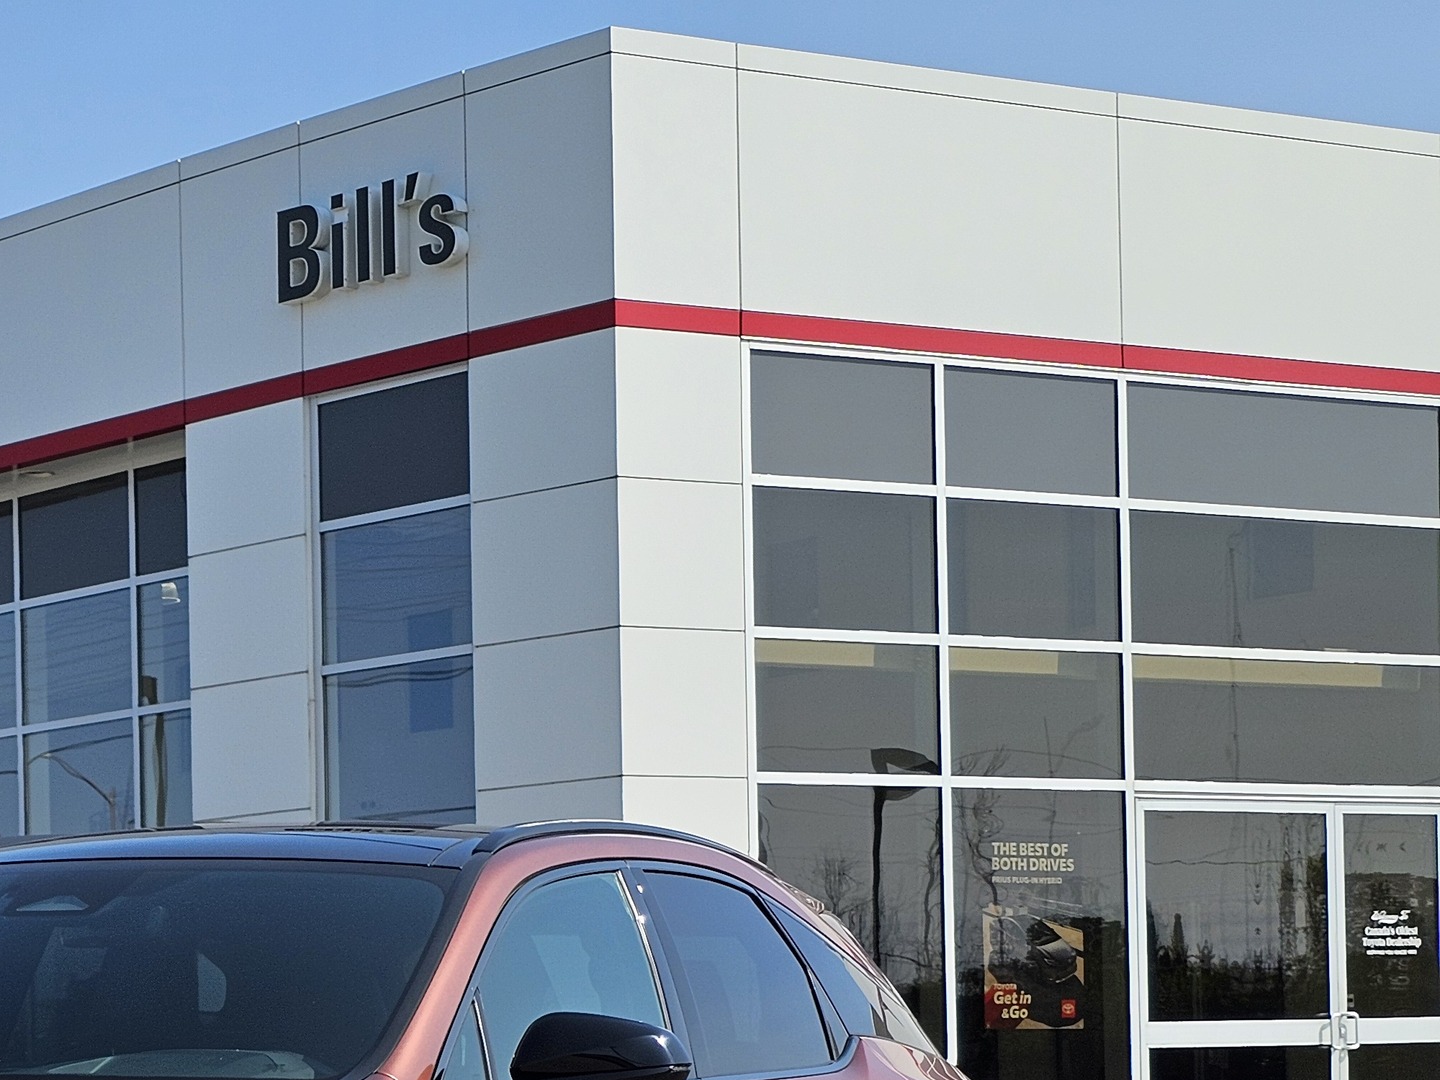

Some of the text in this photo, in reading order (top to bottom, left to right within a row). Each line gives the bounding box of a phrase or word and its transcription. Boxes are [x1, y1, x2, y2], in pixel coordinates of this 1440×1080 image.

[276, 171, 456, 304] Bill's
[991, 842, 1069, 857] THE BEST OF
[991, 857, 1075, 872] BOTH DRIVES
[993, 990, 1032, 1005] Get in
[1001, 1005, 1029, 1019] &Go
